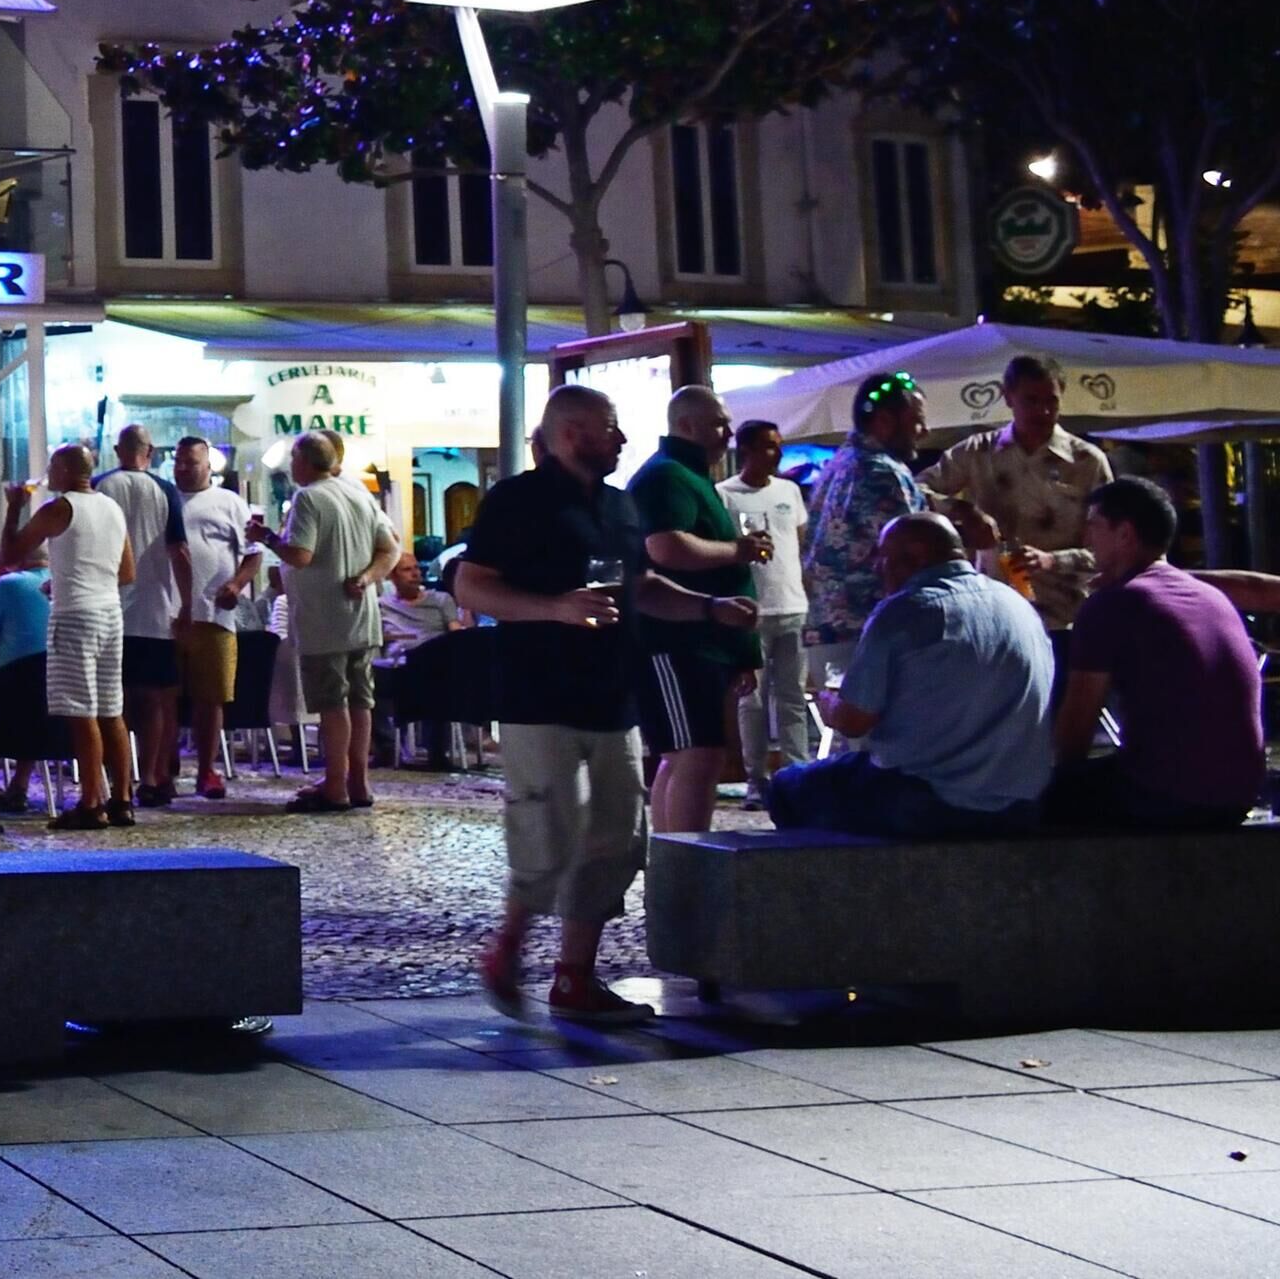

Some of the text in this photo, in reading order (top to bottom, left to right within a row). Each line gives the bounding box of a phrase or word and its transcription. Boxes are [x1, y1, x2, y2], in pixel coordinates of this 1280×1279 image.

[267, 364, 377, 388] CERVEJARIA
[312, 384, 334, 405] A
[274, 408, 375, 436] MARÉ
